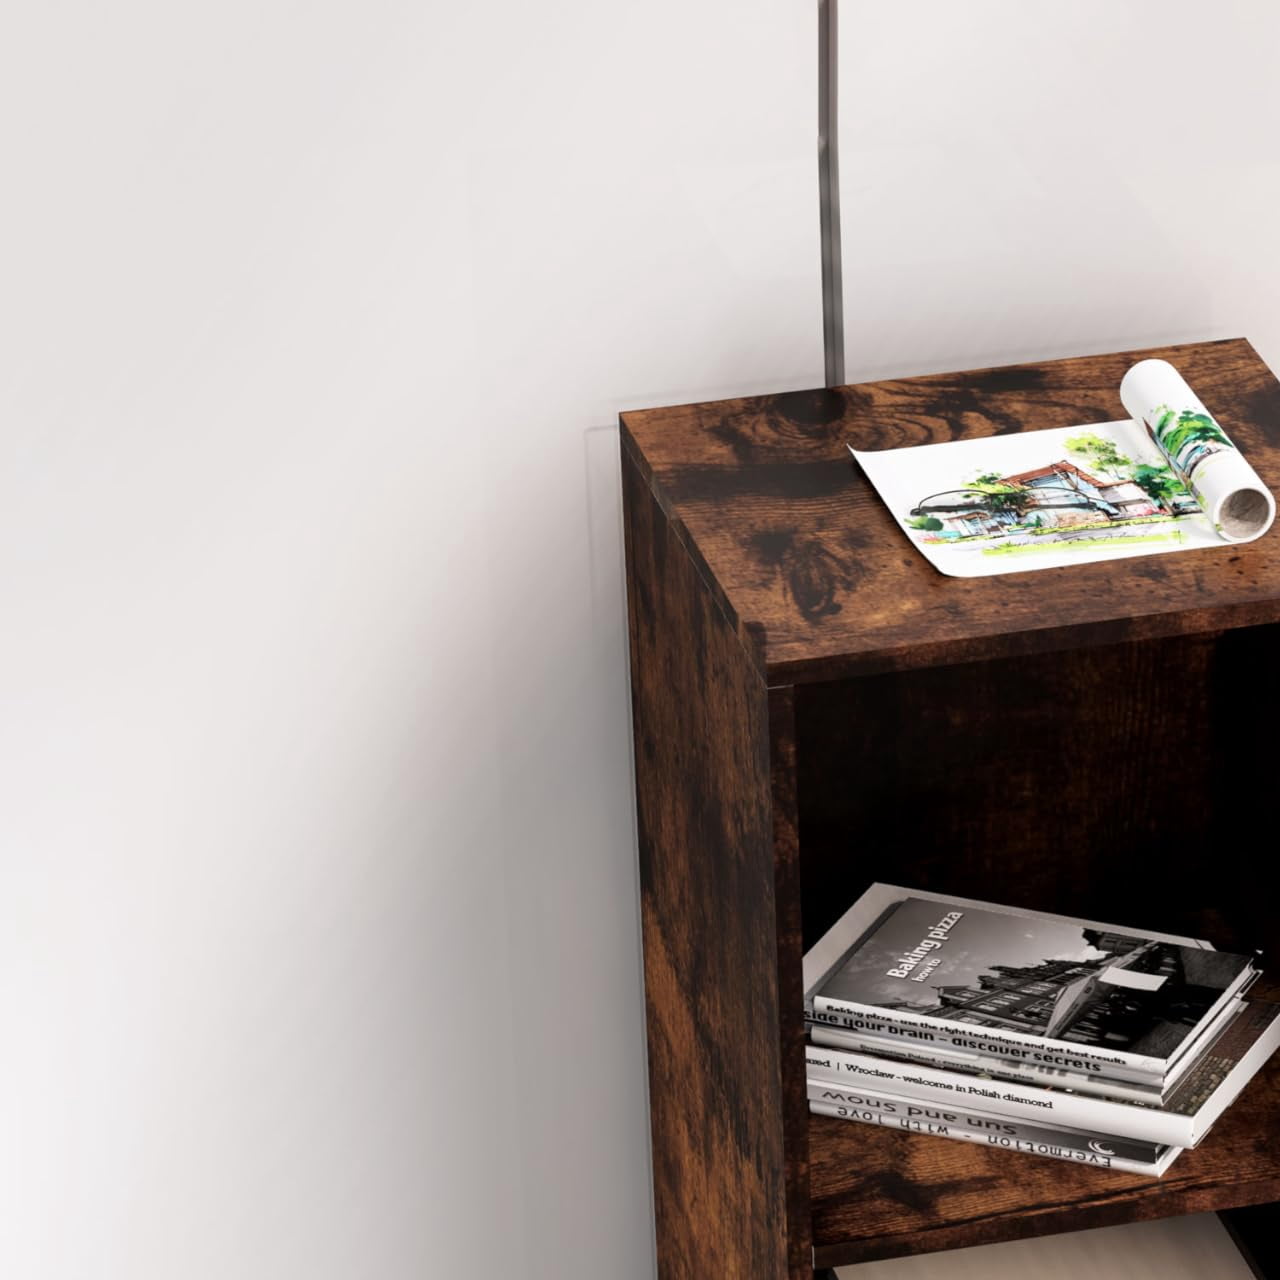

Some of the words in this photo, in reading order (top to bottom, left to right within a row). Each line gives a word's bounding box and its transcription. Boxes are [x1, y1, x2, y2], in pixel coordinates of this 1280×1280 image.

[886, 939, 942, 978] Baking
[927, 911, 964, 941] pizza
[911, 966, 935, 982] how
[927, 958, 941, 967] to
[826, 1004, 865, 1018] Baking
[866, 1012, 893, 1023] pizza
[900, 1019, 918, 1027] use
[920, 1021, 938, 1031] the
[939, 1025, 967, 1037] right
[968, 1031, 1022, 1047] technique
[1023, 1042, 1045, 1050] and
[1046, 1045, 1065, 1055] get
[1066, 1047, 1090, 1058] best
[1091, 1053, 1127, 1065] results
[843, 1017, 885, 1031] your
[952, 1034, 1030, 1058] discover
[1033, 1052, 1102, 1072] secrets
[902, 1073, 953, 1090] welcome
[955, 1083, 966, 1092] in
[967, 1086, 1001, 1100] Polish
[1002, 1092, 1054, 1109] diamond
[837, 1106, 883, 1125] love
[900, 1118, 950, 1135] with
[907, 1106, 957, 1122] and
[966, 1117, 1018, 1136] Sun
[987, 1135, 1112, 1168] Evermotion
